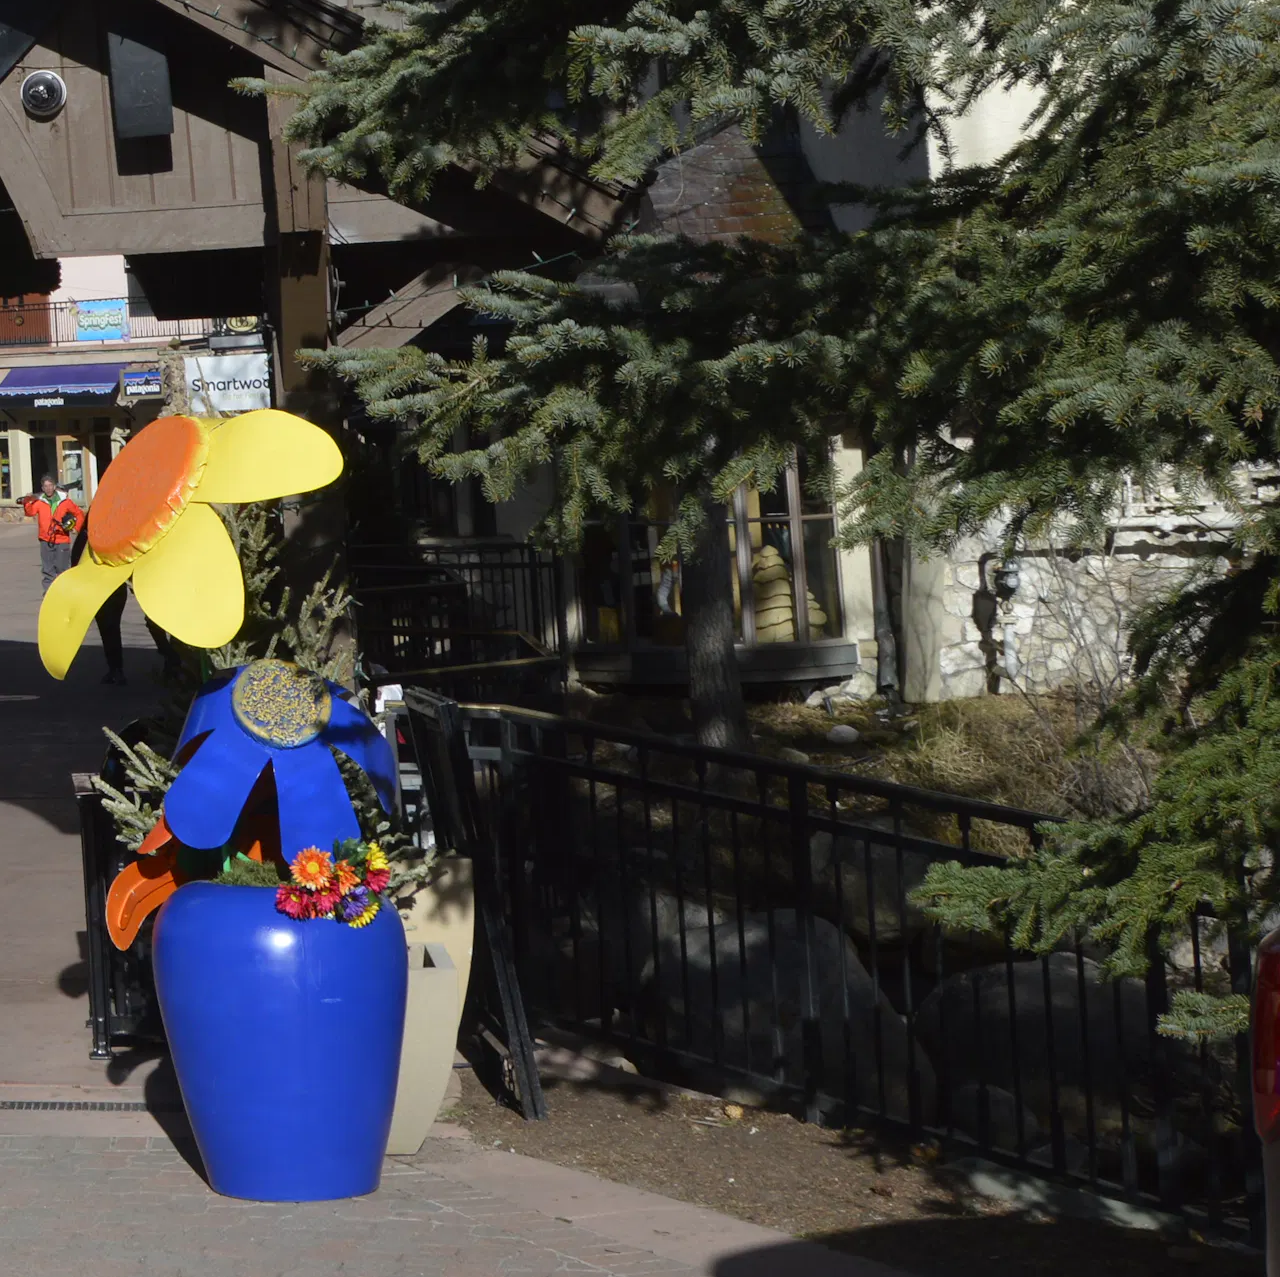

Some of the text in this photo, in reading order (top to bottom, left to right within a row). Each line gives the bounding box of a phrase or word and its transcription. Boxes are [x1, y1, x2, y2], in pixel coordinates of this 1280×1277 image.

[78, 313, 123, 330] SpringFest
[126, 384, 160, 395] patagonia
[34, 398, 64, 408] patagonia
